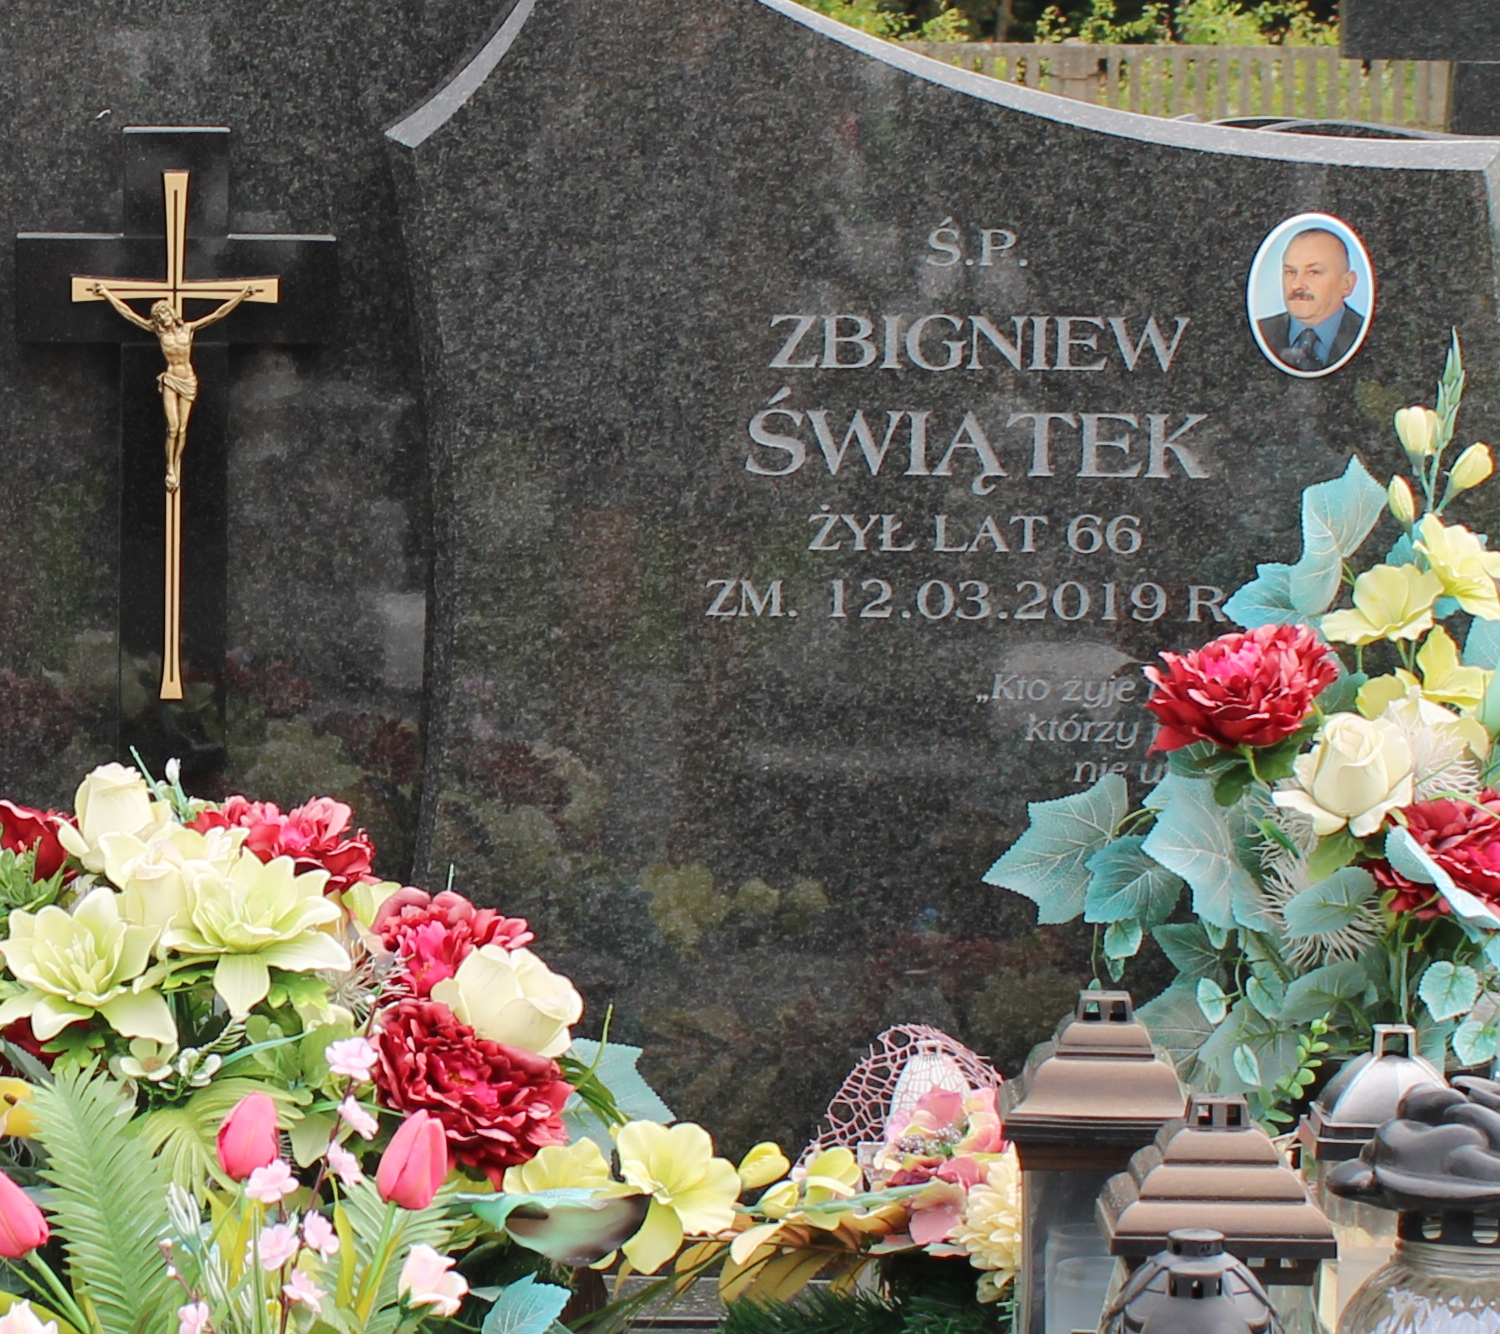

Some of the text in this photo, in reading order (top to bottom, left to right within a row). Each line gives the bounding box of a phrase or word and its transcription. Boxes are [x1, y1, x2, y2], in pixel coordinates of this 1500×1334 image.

[926, 217, 1029, 268] Ś.P.
[769, 314, 1190, 372] ZBIGNIEW
[744, 387, 1210, 496] ŚWIĄTEK
[808, 504, 1143, 555] ŻYŁ LAT 66
[705, 579, 798, 618] ZM.
[829, 580, 1168, 622] 12.03.2019
[1025, 713, 1139, 750] którzy
